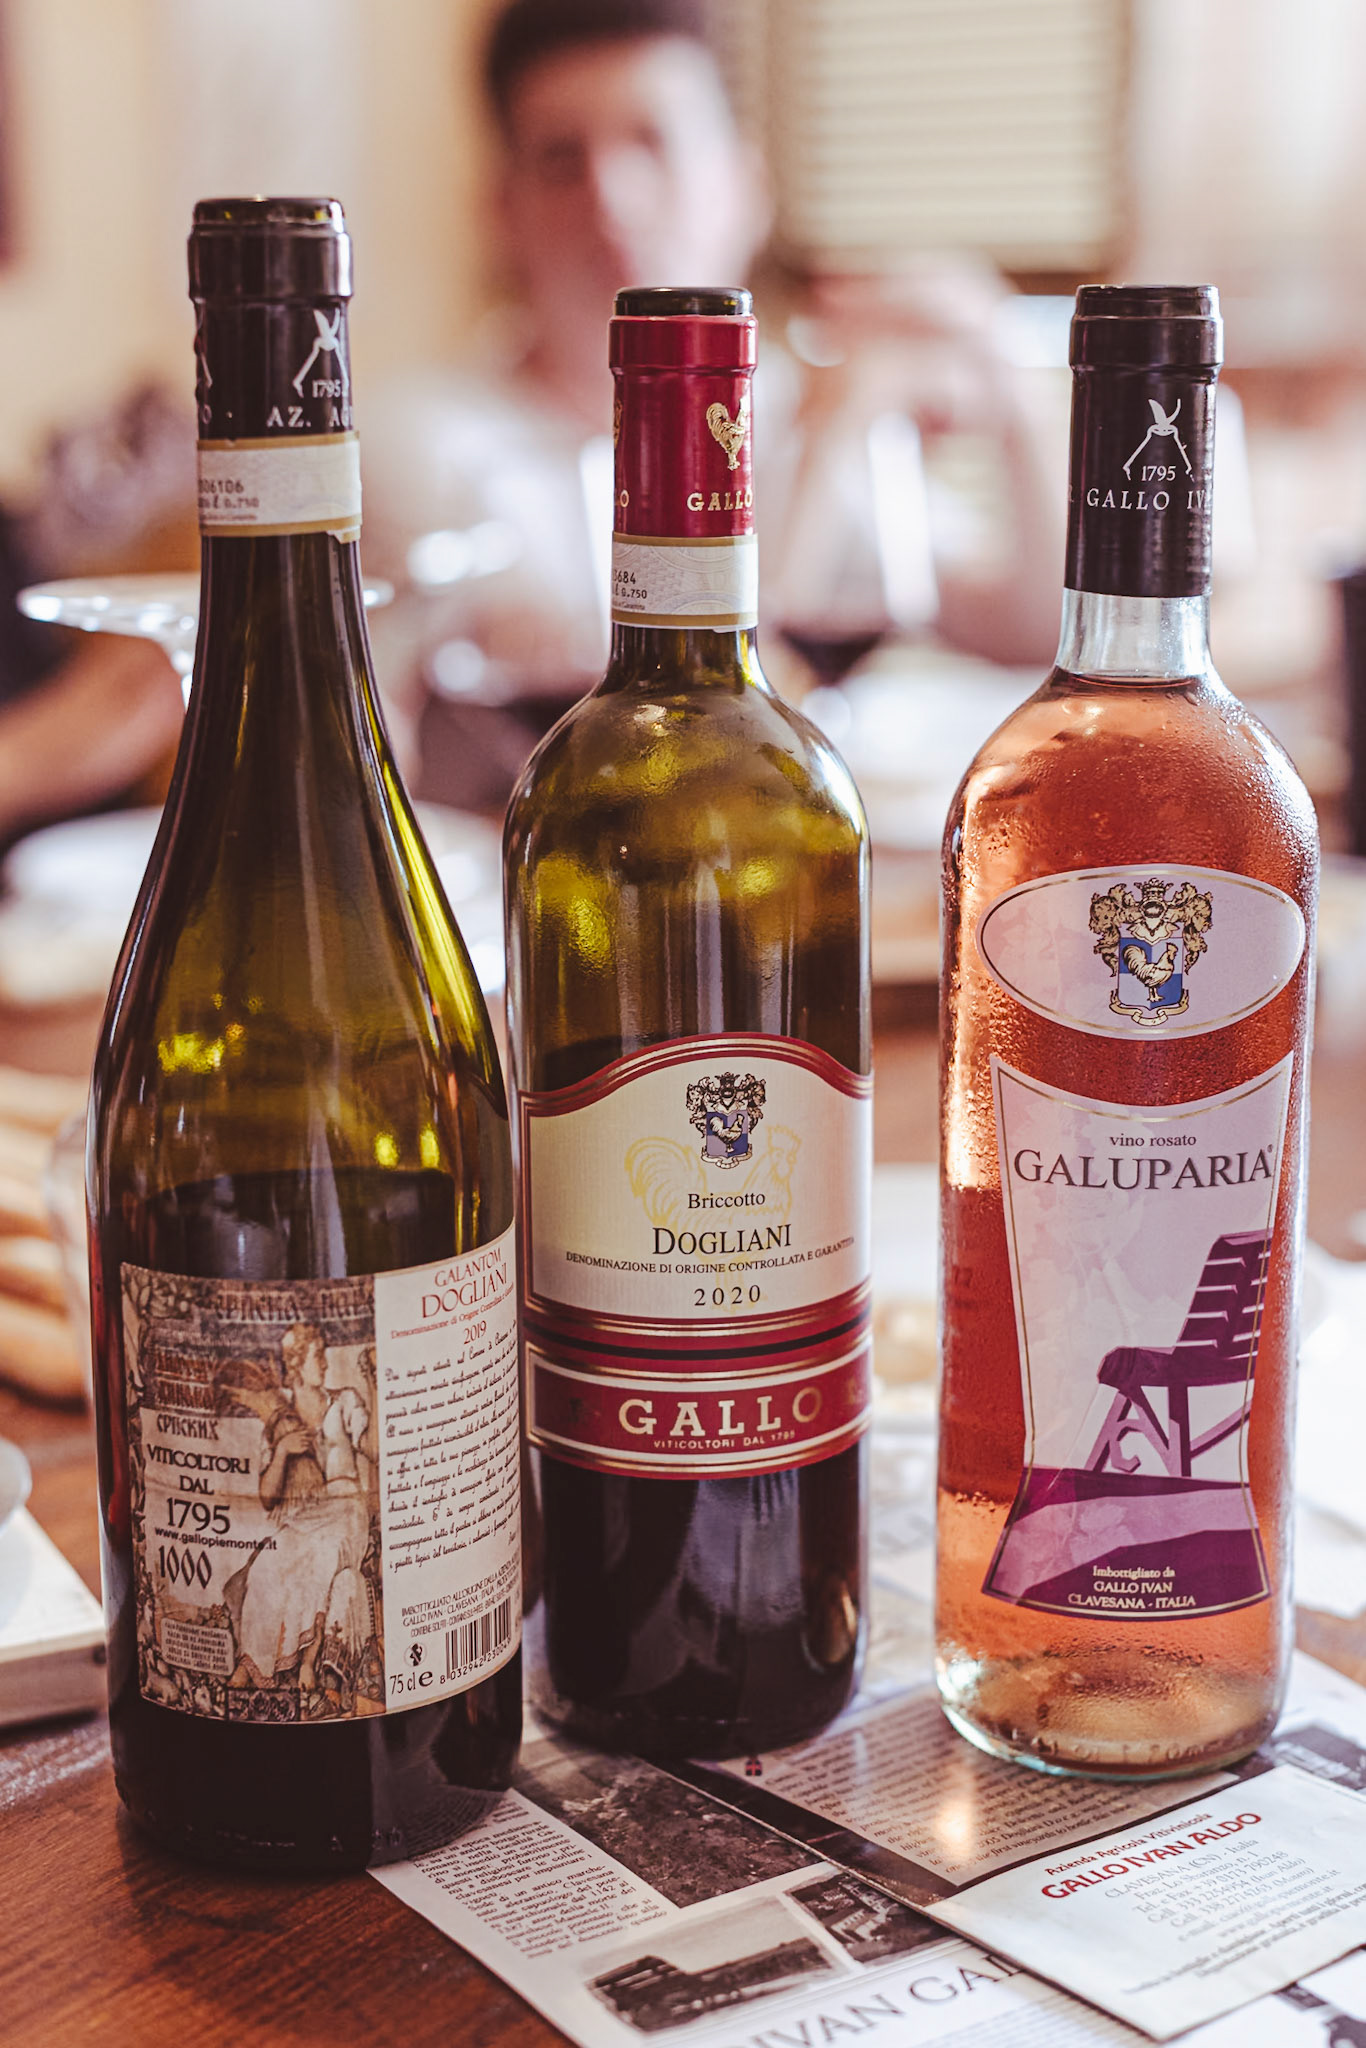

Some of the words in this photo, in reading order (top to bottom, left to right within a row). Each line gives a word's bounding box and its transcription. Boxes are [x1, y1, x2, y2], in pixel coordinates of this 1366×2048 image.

[1141, 465, 1177, 482] 1795
[687, 492, 753, 511] GALLO
[1087, 488, 1170, 510] GALLO
[1110, 1134, 1145, 1148] vino
[1150, 1134, 1197, 1148] rosato
[688, 1192, 766, 1210] Briccotto
[652, 1224, 792, 1255] DOGLIANI
[566, 1251, 656, 1274] DENOMINAZIONE
[660, 1264, 672, 1274] DI
[675, 1264, 725, 1274] ORIGINE
[728, 1253, 806, 1272] CONTROLLATA
[807, 1251, 813, 1260] E
[421, 1262, 507, 1318] DOGLIANI
[694, 1284, 761, 1306] 2020
[463, 1320, 486, 1344] 2019
[619, 1387, 822, 1437] GALLO
[653, 1438, 735, 1449] VITICOLTORI
[743, 1435, 765, 1446] DAL
[147, 1443, 250, 1474] VITICOLTORI
[179, 1475, 215, 1495] DAL
[166, 1496, 231, 1535] 1795
[1093, 1565, 1161, 1580] Imbottigliato
[1163, 1566, 1175, 1578] da
[1094, 1581, 1138, 1594] GALLO
[1141, 1581, 1173, 1594] IVAN
[1068, 1593, 1145, 1609] CLAVESANA
[1155, 1595, 1196, 1609] ITALIA
[403, 1613, 426, 1627] GALLO
[390, 1674, 404, 1695] 75
[407, 1672, 416, 1691] cl
[1041, 1863, 1129, 1899] GALLO
[1124, 1840, 1197, 1868] IVAN
[1188, 1812, 1262, 1845] ALDO
[1045, 1855, 1098, 1877] Azienda
[1098, 1838, 1145, 1859] Agricola
[1144, 1812, 1213, 1840] Vitivinicola
[1104, 1865, 1190, 1898] CLAVESANA
[1225, 1839, 1259, 1854] Italia
